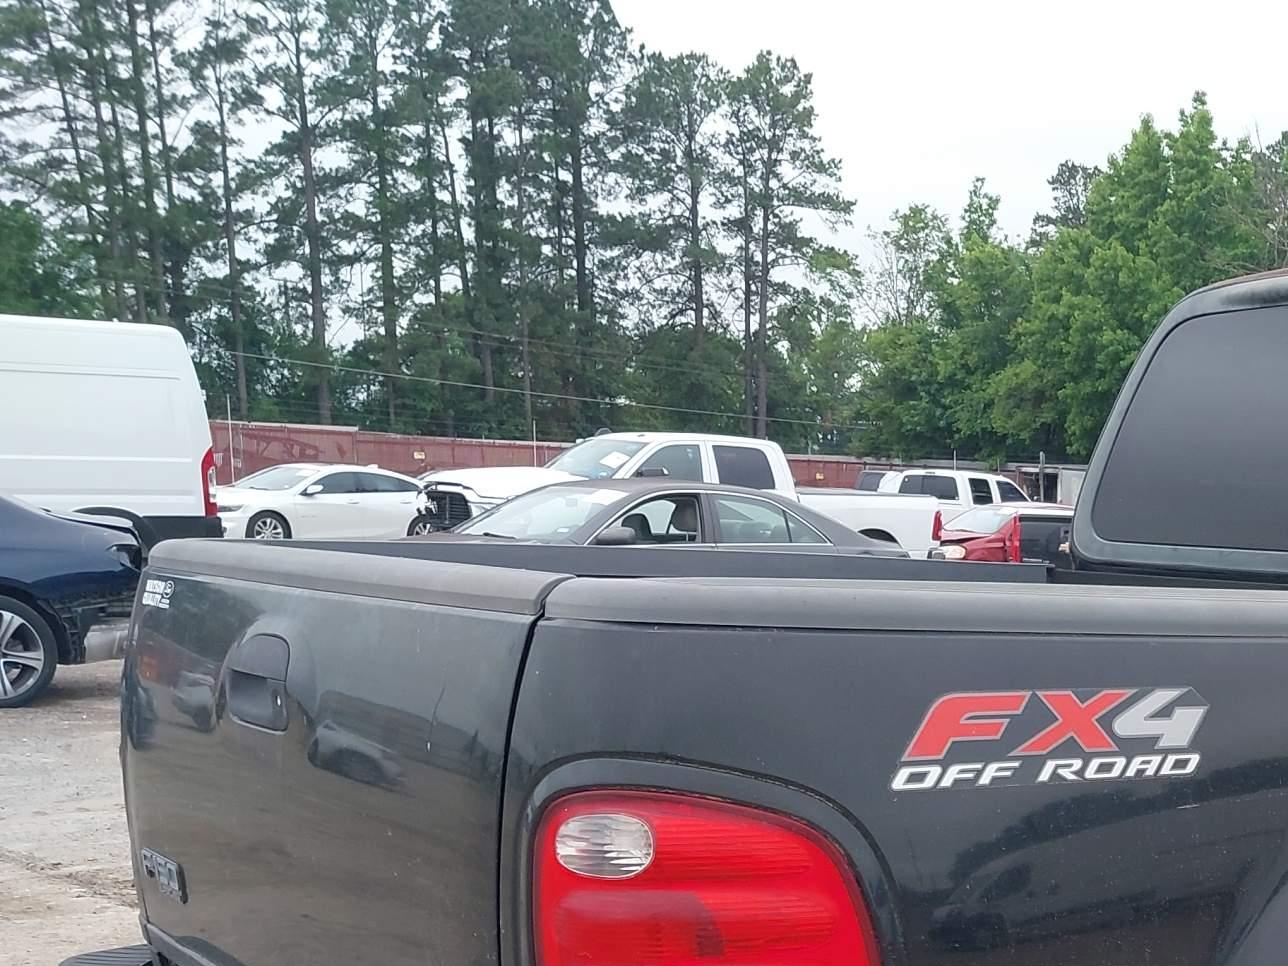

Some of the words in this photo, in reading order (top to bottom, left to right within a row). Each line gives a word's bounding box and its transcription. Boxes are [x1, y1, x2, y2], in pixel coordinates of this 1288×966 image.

[900, 687, 1210, 762] FX4
[890, 759, 1022, 791] OFF
[1035, 752, 1201, 784] ROAD
